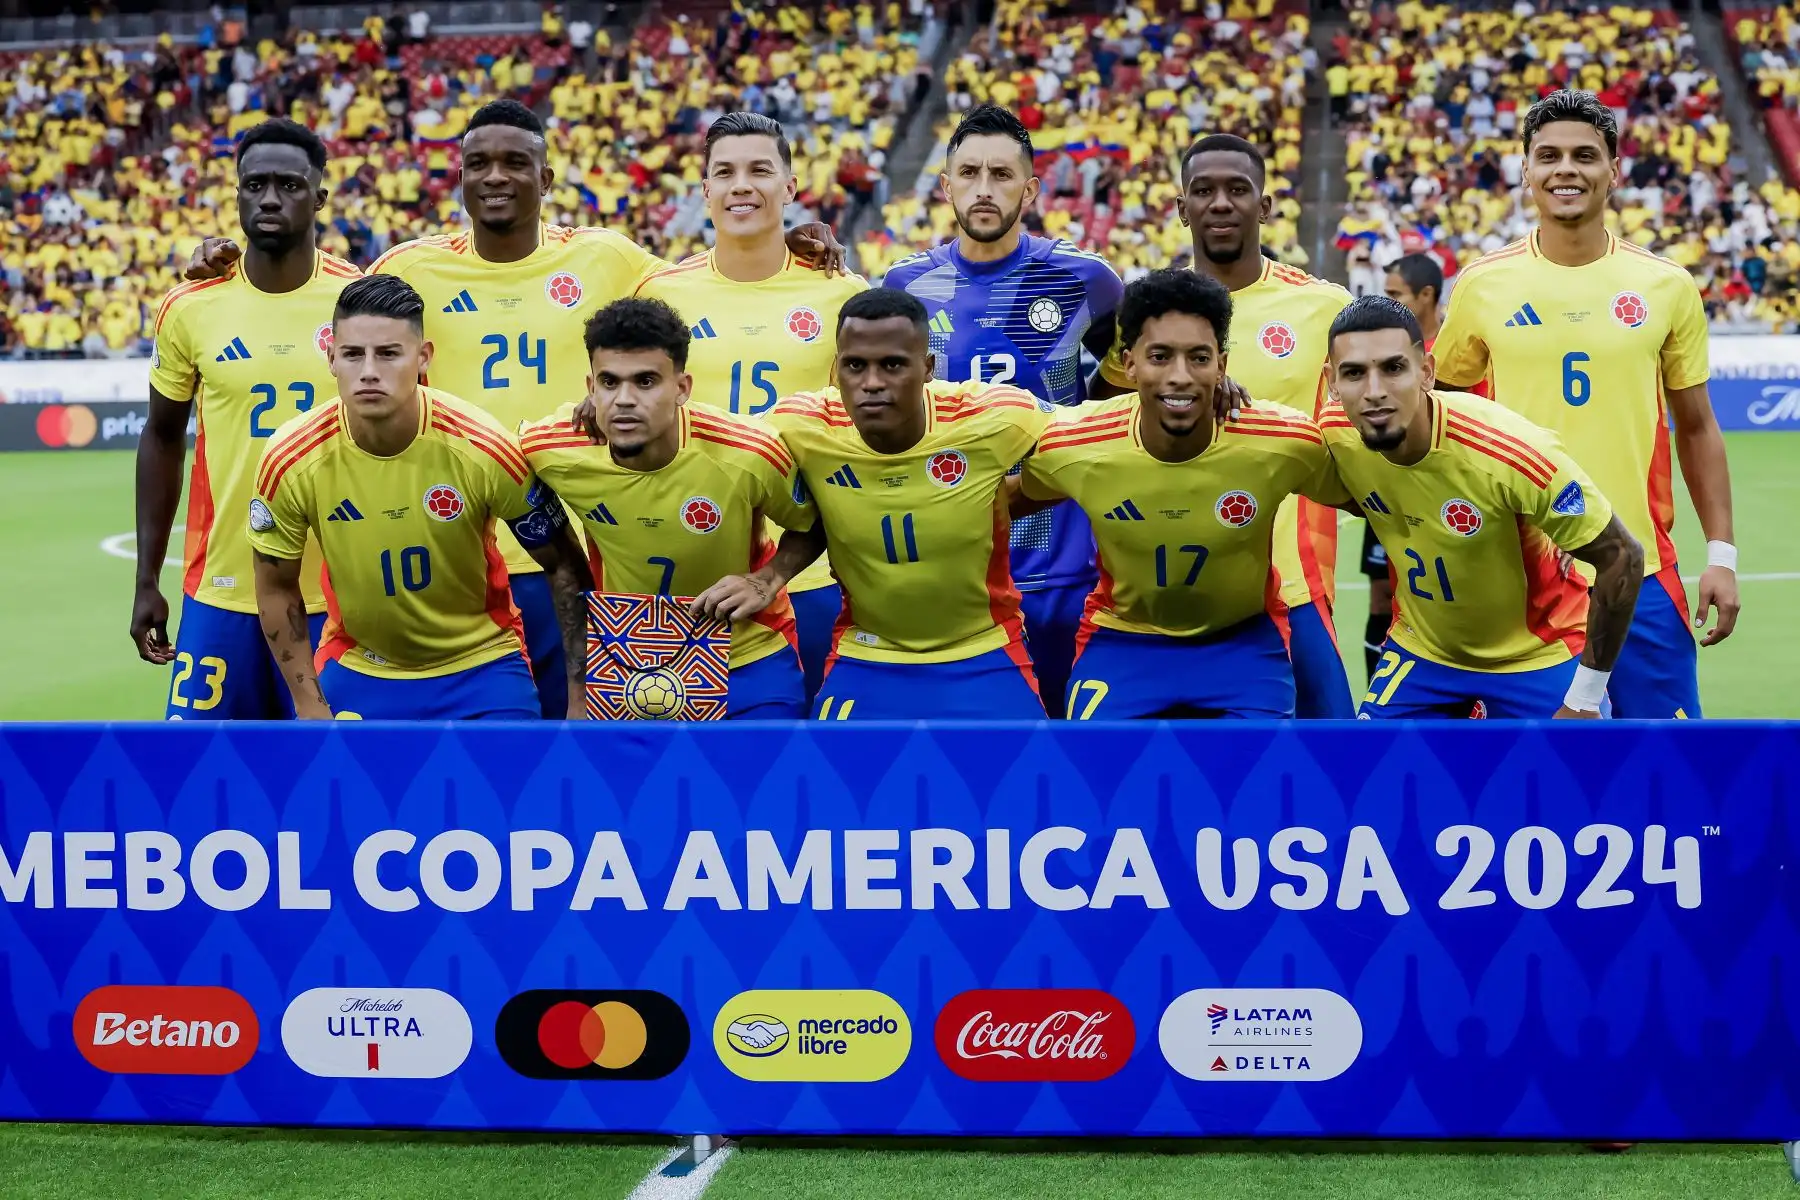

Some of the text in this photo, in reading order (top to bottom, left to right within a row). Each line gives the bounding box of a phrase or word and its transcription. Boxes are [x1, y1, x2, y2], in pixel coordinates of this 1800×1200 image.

[481, 332, 546, 389] 24
[1563, 352, 1590, 406] 6
[250, 381, 315, 438] 23
[730, 361, 779, 416] 15
[881, 513, 919, 564] 11
[381, 546, 431, 596] 10
[648, 557, 675, 596] 7
[1155, 544, 1209, 587] 17
[1405, 548, 1454, 601] 21
[171, 652, 227, 711] 23
[1066, 680, 1109, 720] 17
[1364, 651, 1415, 706] 21
[0, 829, 331, 911] MEBOL
[353, 830, 648, 912] COPA
[663, 826, 1170, 911] AMERICA
[1196, 825, 1410, 915] USA
[1436, 823, 1701, 909] 2024
[328, 1017, 422, 1037] ULTRA
[340, 998, 404, 1013] Michelob
[799, 1015, 898, 1034] mercado
[1234, 1008, 1312, 1021] LATAM
[93, 1012, 240, 1048] Betano
[799, 1035, 847, 1055] libre
[957, 1010, 1112, 1060] Coca-Cola
[1234, 1027, 1313, 1036] AIRLINES
[1236, 1056, 1311, 1070] DELTA
